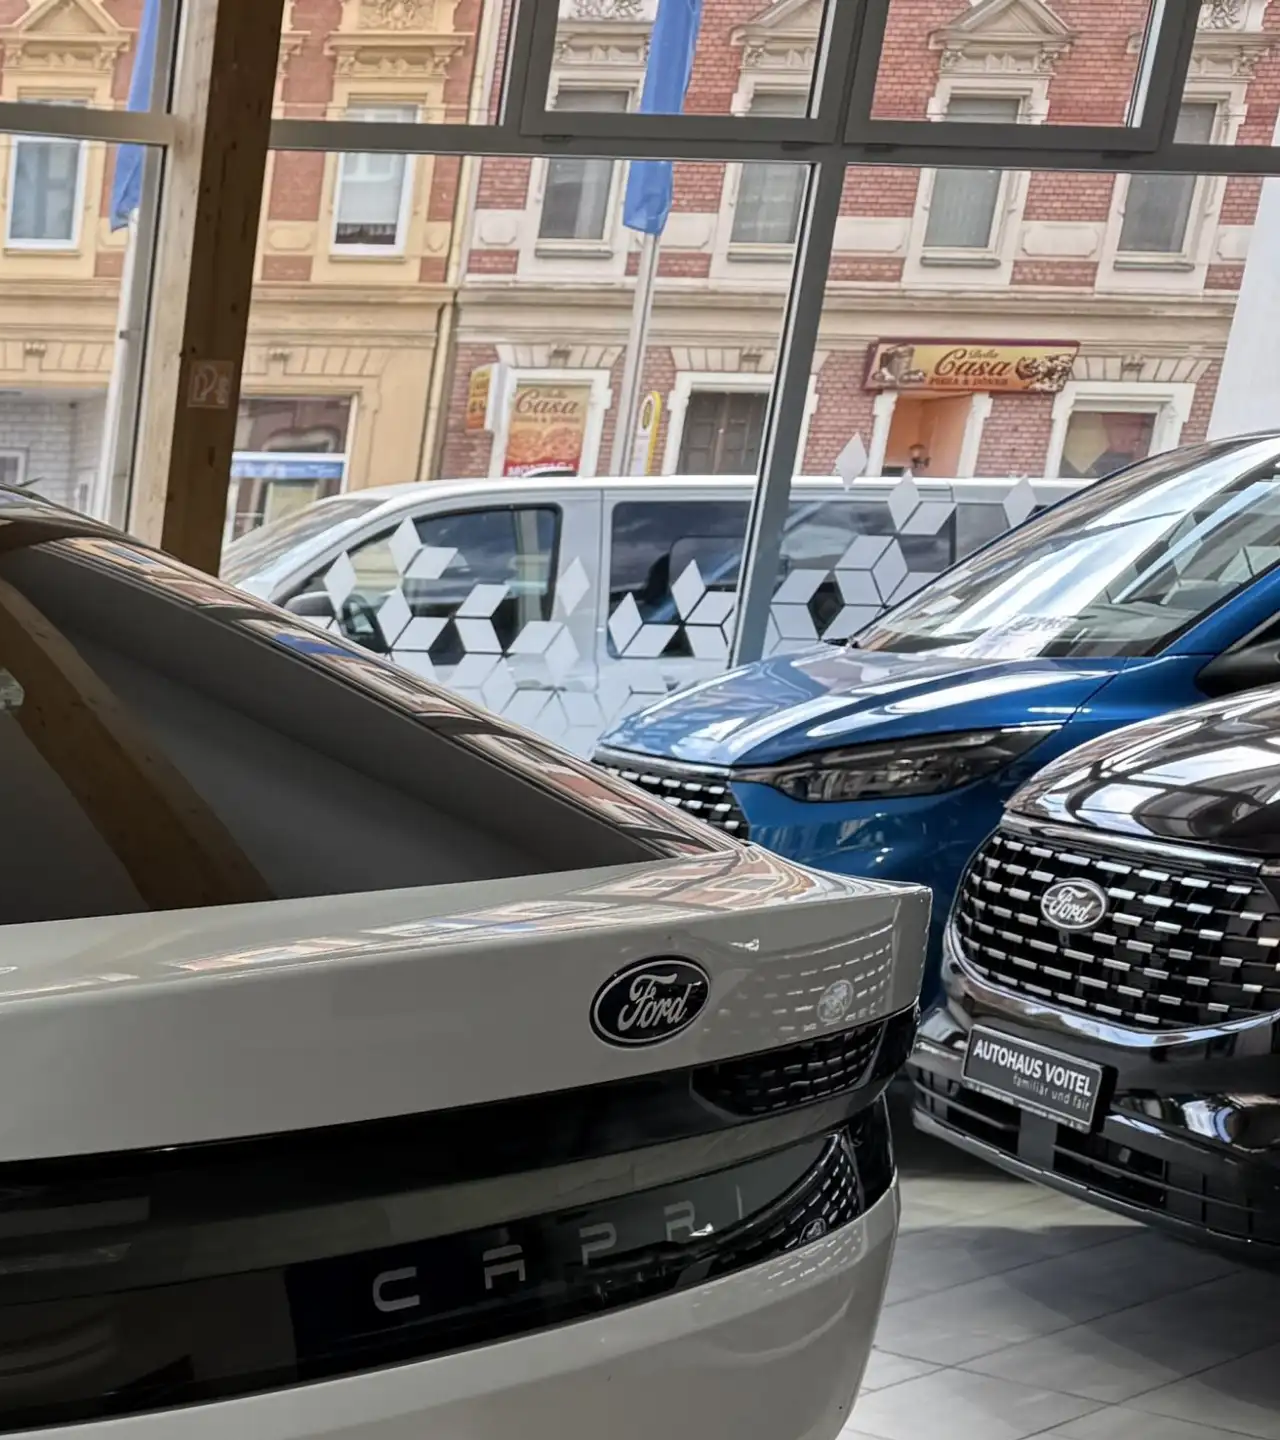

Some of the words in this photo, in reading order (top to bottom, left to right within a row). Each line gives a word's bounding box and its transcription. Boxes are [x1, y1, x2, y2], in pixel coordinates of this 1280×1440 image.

[934, 348, 1011, 377] Casa
[515, 388, 579, 415] Casa
[1048, 886, 1096, 924] Ford
[616, 972, 691, 1032] Ford
[973, 1039, 1043, 1080] AUTOHAUS
[1044, 1062, 1092, 1098] VOITEL
[1051, 1088, 1072, 1106] und
[1072, 1094, 1091, 1113] fair
